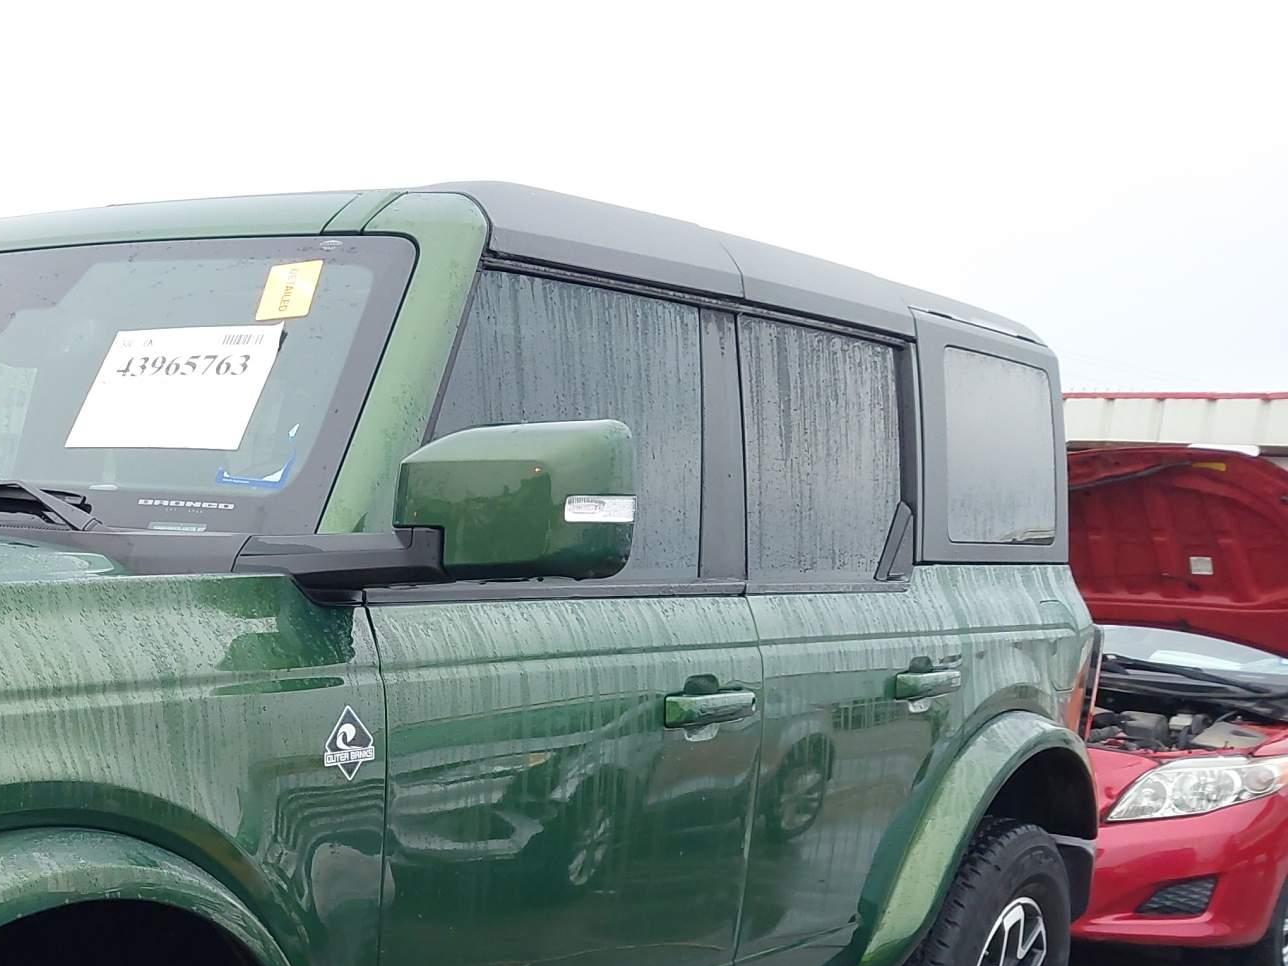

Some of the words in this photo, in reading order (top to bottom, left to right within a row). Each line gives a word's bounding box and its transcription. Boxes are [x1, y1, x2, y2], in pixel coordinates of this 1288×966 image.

[116, 354, 251, 376] 43965763
[327, 753, 349, 763] OUTER
[351, 749, 372, 760] BANKS
